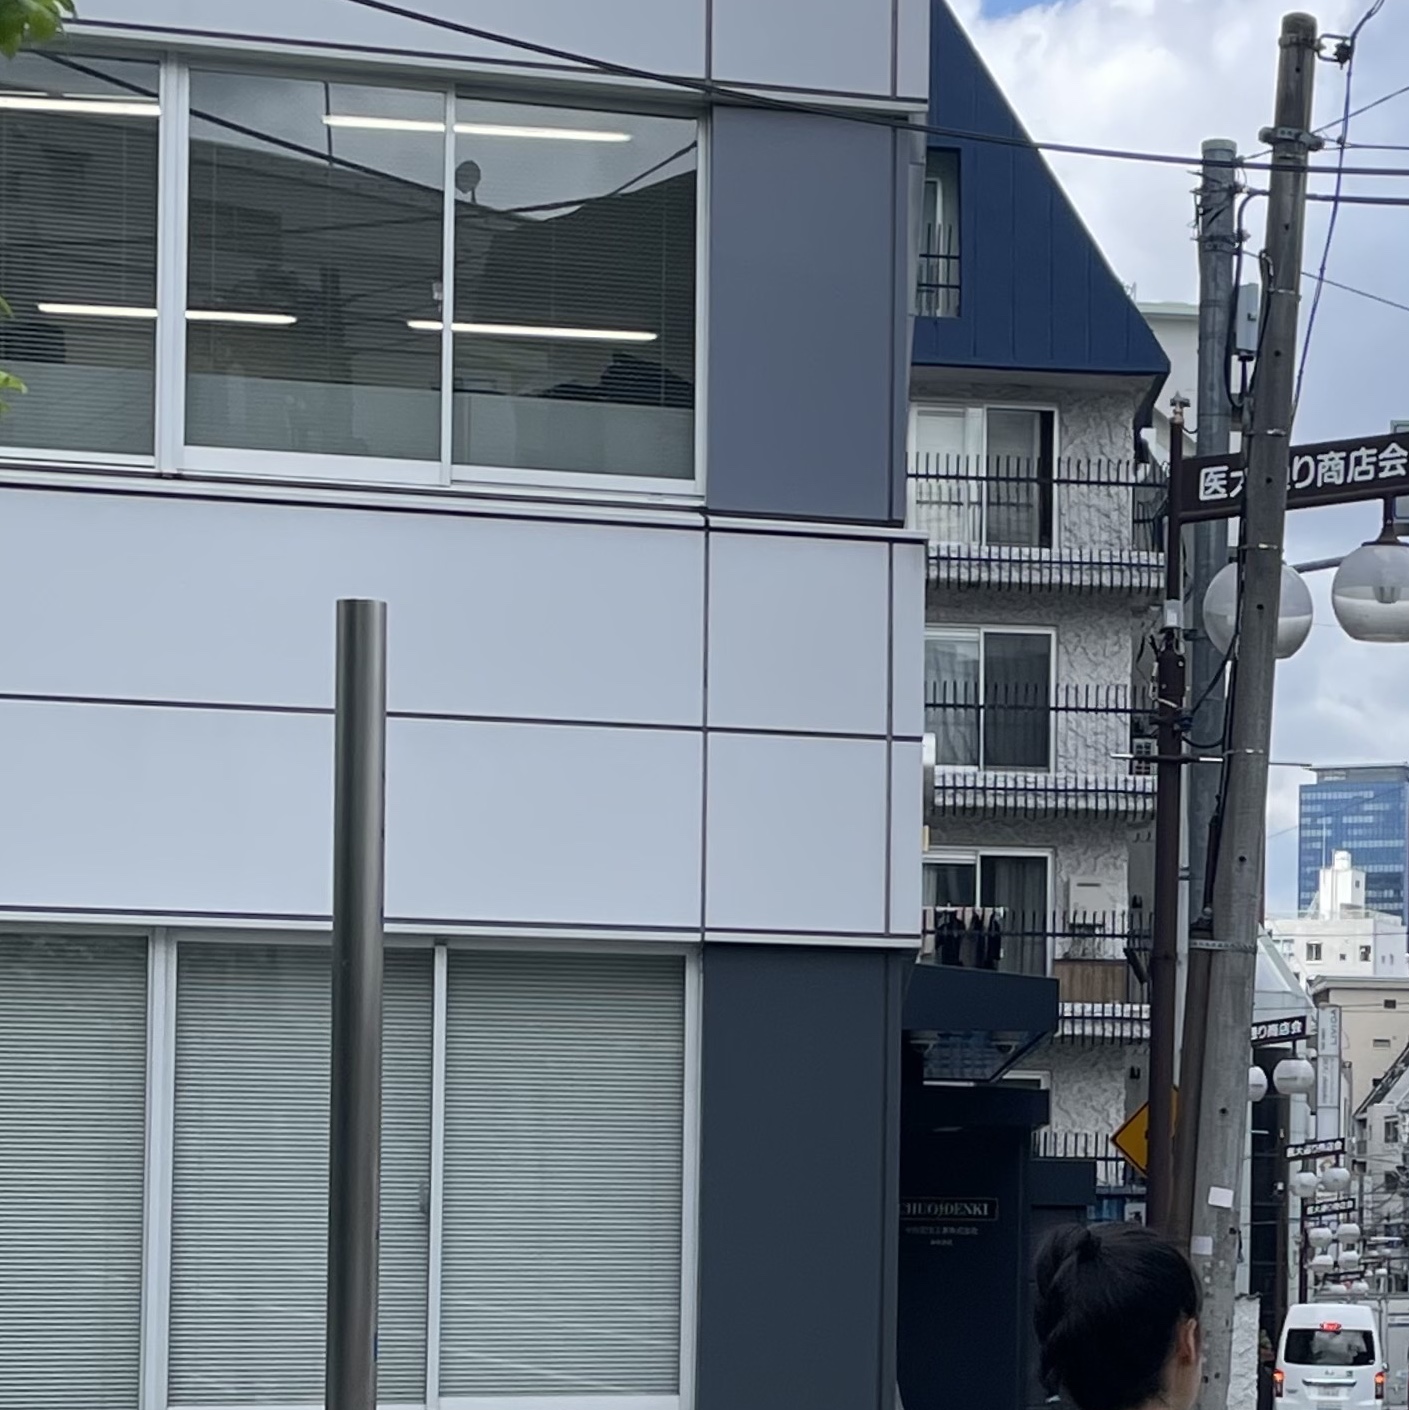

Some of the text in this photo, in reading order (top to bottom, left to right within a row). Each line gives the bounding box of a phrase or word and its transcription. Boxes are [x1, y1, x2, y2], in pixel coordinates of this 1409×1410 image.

[1199, 442, 1409, 501] 医り商店会
